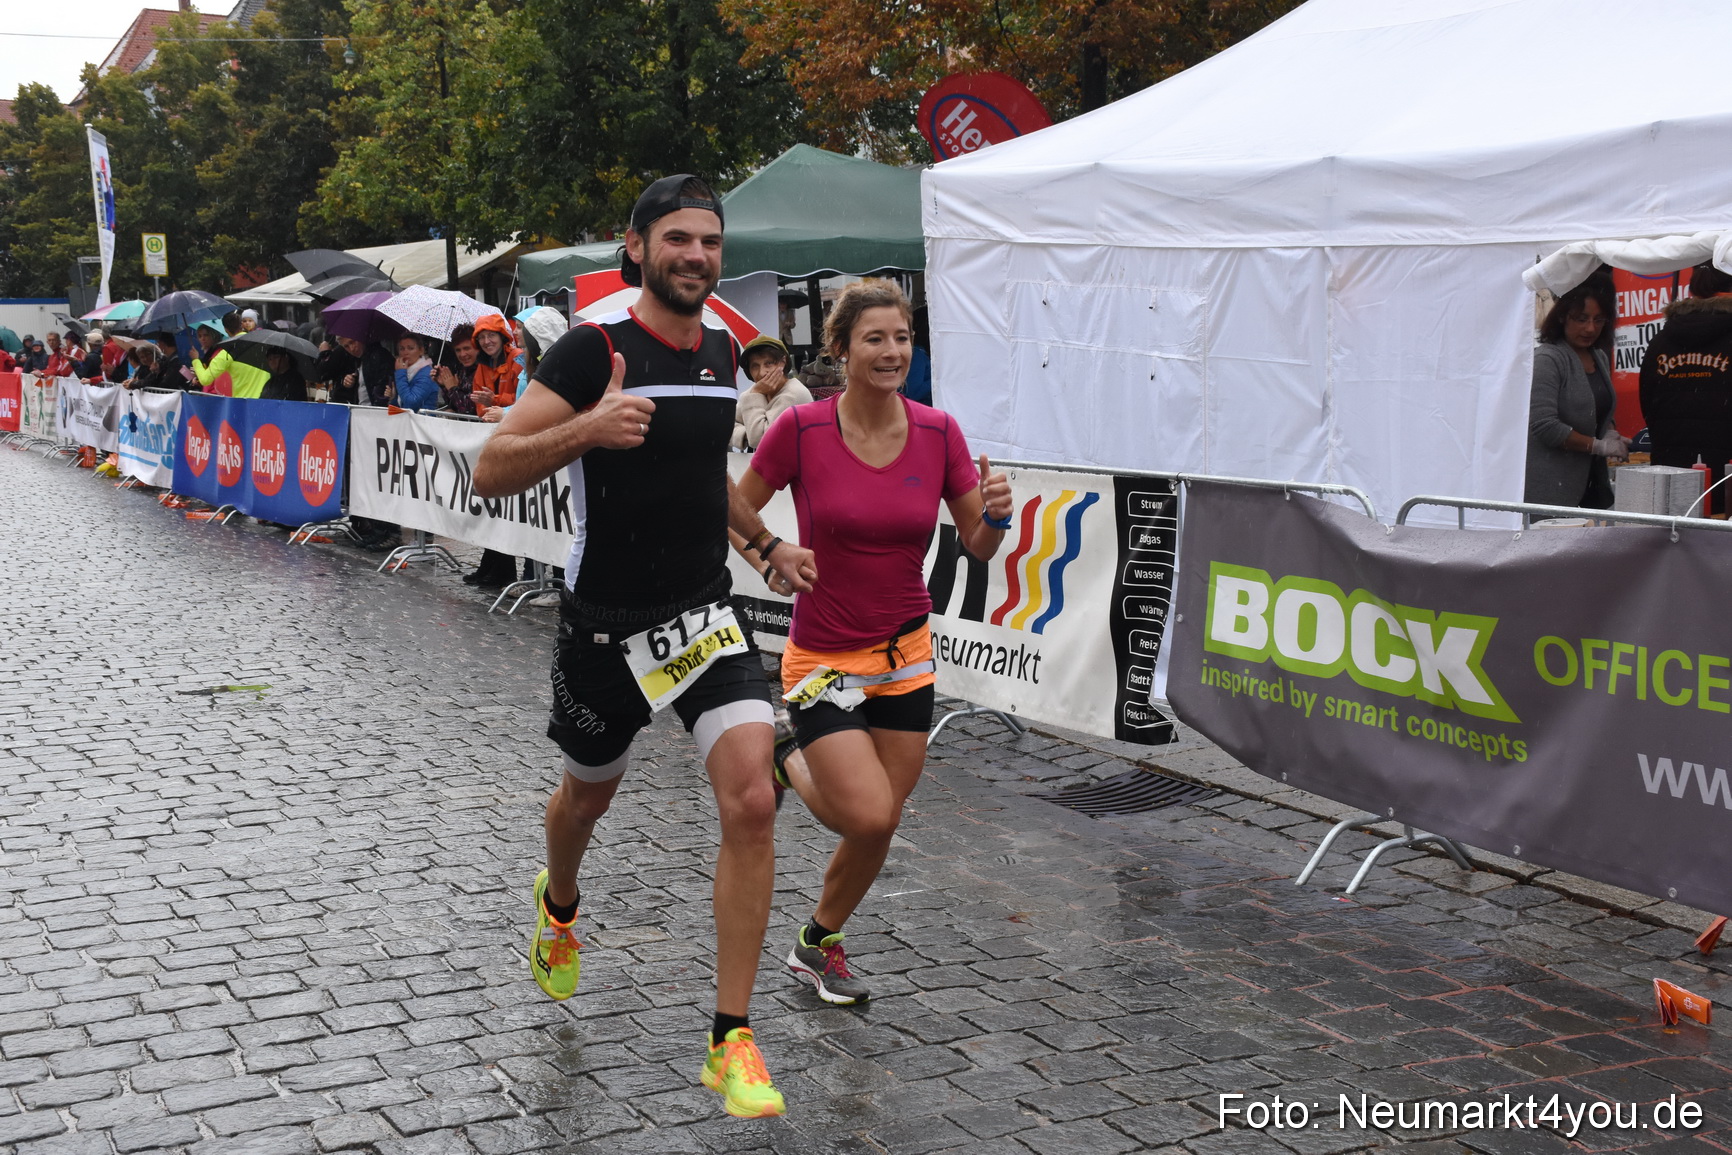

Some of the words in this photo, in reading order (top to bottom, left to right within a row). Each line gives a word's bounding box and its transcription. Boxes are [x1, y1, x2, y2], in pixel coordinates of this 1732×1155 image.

[939, 132, 966, 156] SPO
[940, 100, 993, 151] He
[252, 437, 285, 483] Hervis
[300, 443, 336, 493] Hervis
[376, 437, 443, 507] PARTL
[448, 451, 576, 538] Neumark
[1140, 499, 1163, 510] Strom
[1134, 569, 1165, 580] Wasser
[647, 605, 711, 662] 617
[1139, 604, 1164, 617] Wärme
[930, 631, 1042, 685] neumarkt
[1209, 573, 1497, 707] BOCK
[1533, 635, 1731, 714] OFFICE
[1201, 659, 1285, 703] inspired
[1290, 686, 1318, 718] by
[1323, 695, 1400, 732] smart
[1406, 714, 1528, 763] concepts
